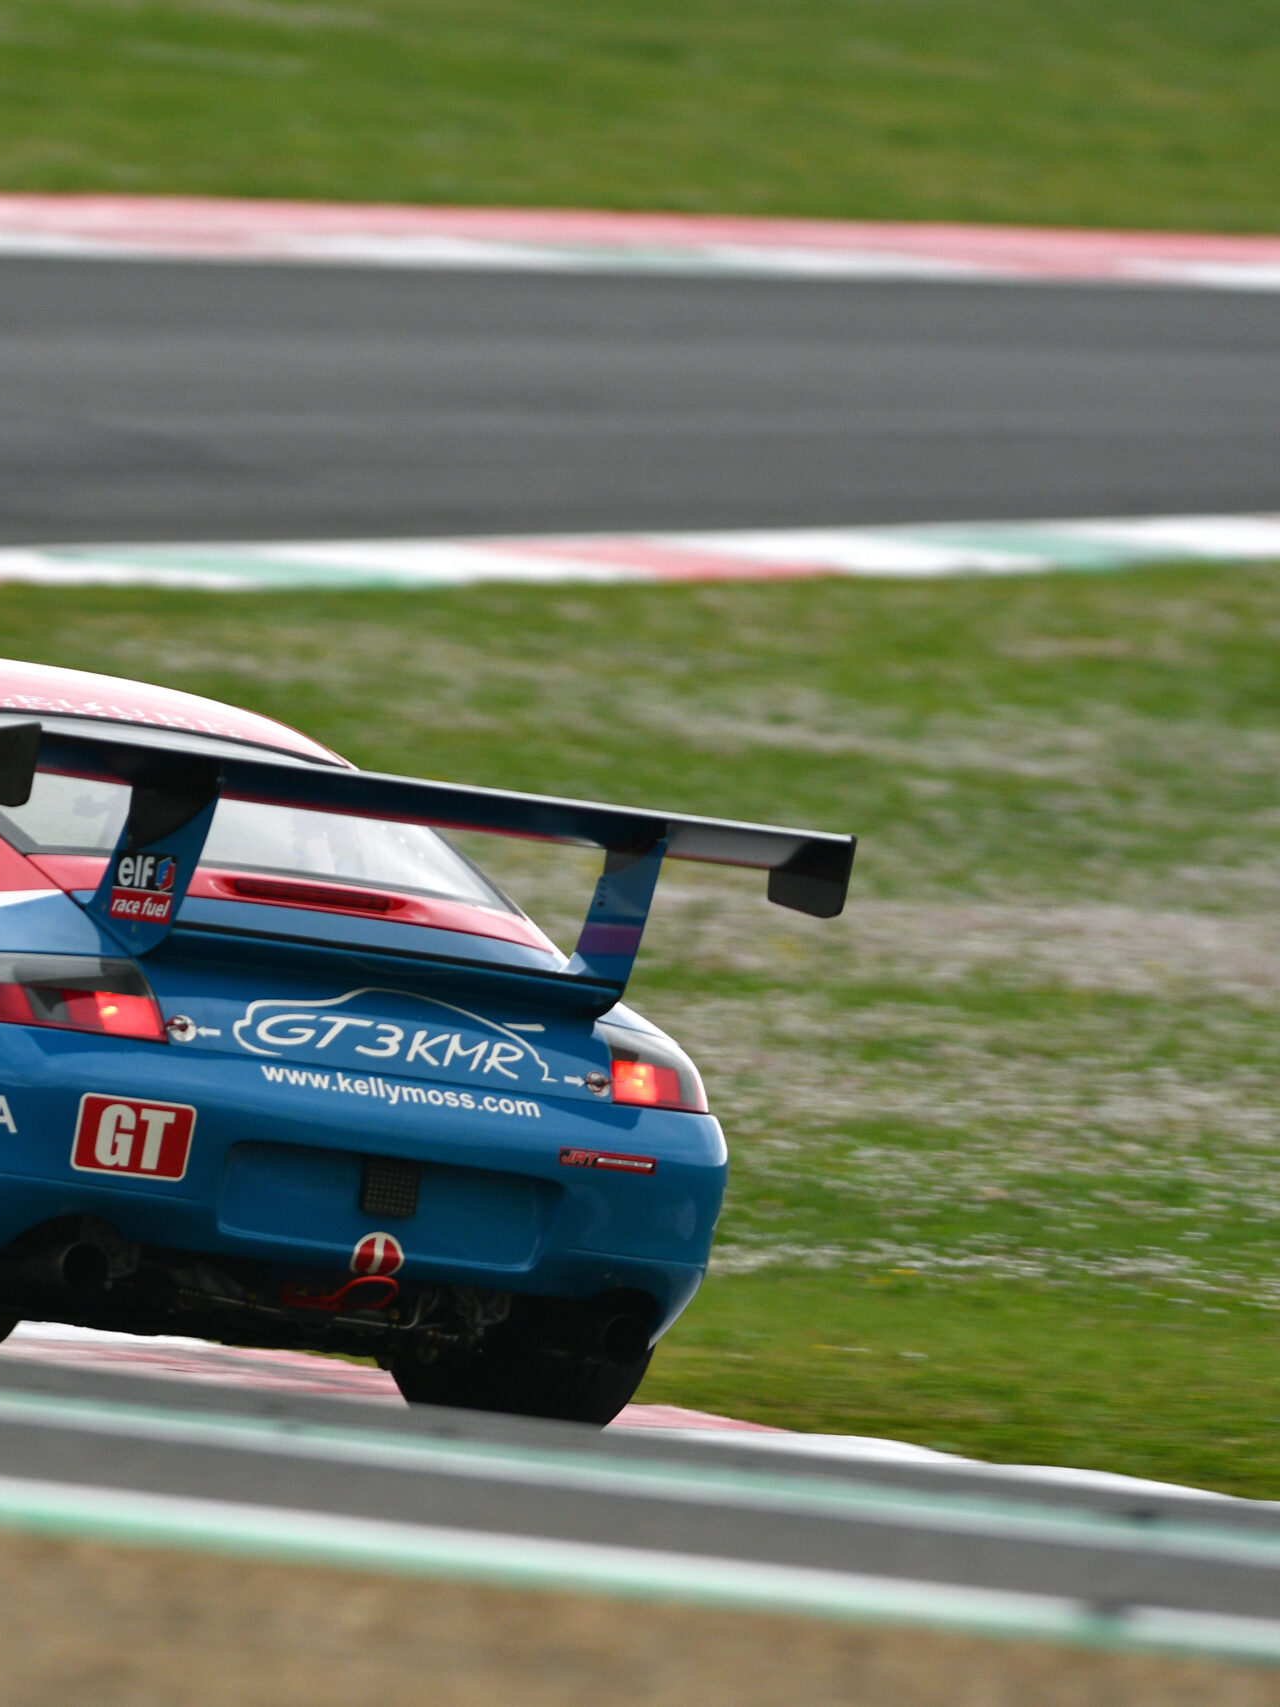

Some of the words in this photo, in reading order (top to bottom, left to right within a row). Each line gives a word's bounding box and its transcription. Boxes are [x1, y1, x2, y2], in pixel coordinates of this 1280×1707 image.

[118, 855, 155, 888] elf
[111, 898, 140, 914] race
[141, 897, 171, 918] fuel
[261, 1065, 541, 1118] www.kellymoss.com
[94, 1103, 176, 1171] GT
